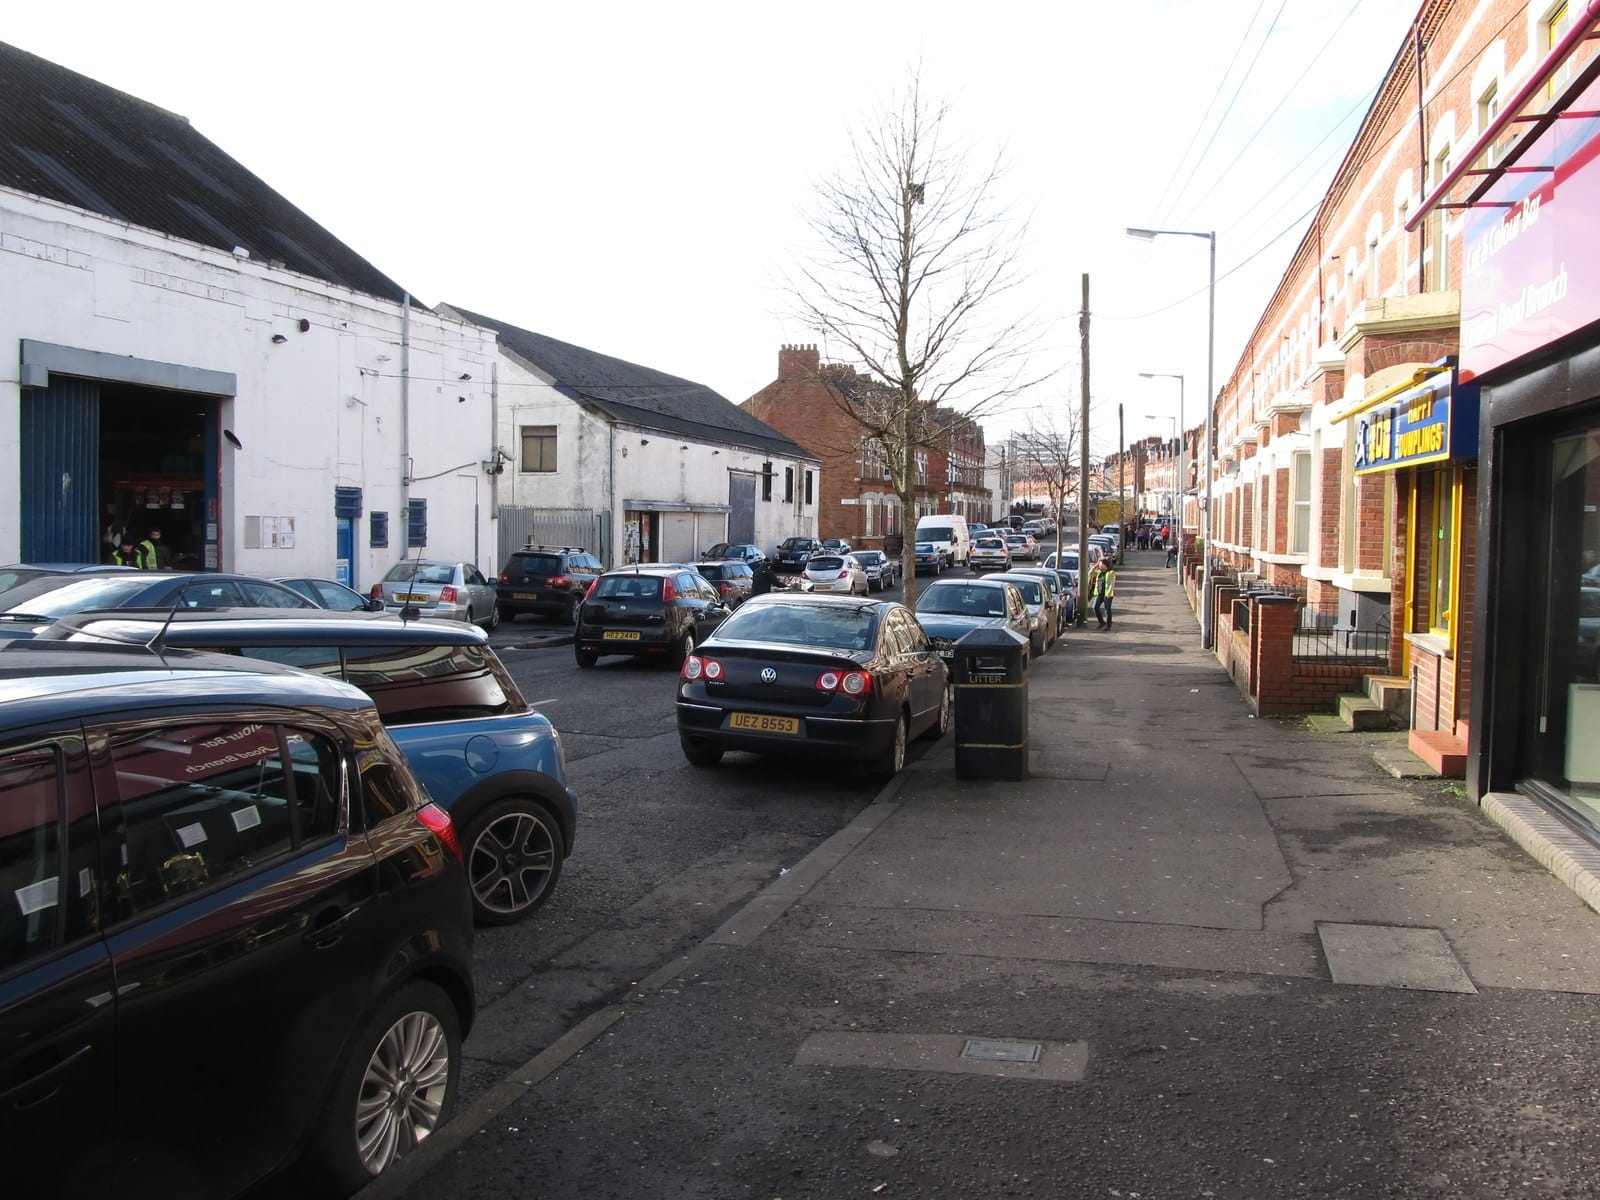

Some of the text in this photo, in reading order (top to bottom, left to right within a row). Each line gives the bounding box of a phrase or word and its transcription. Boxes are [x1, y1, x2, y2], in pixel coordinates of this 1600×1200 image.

[1520, 194, 1541, 232] Bar
[1523, 261, 1568, 319] Branch
[1398, 422, 1443, 458] DUMPLINGS
[969, 675, 1002, 684] LITTER
[735, 714, 793, 732] UEZ 8553
